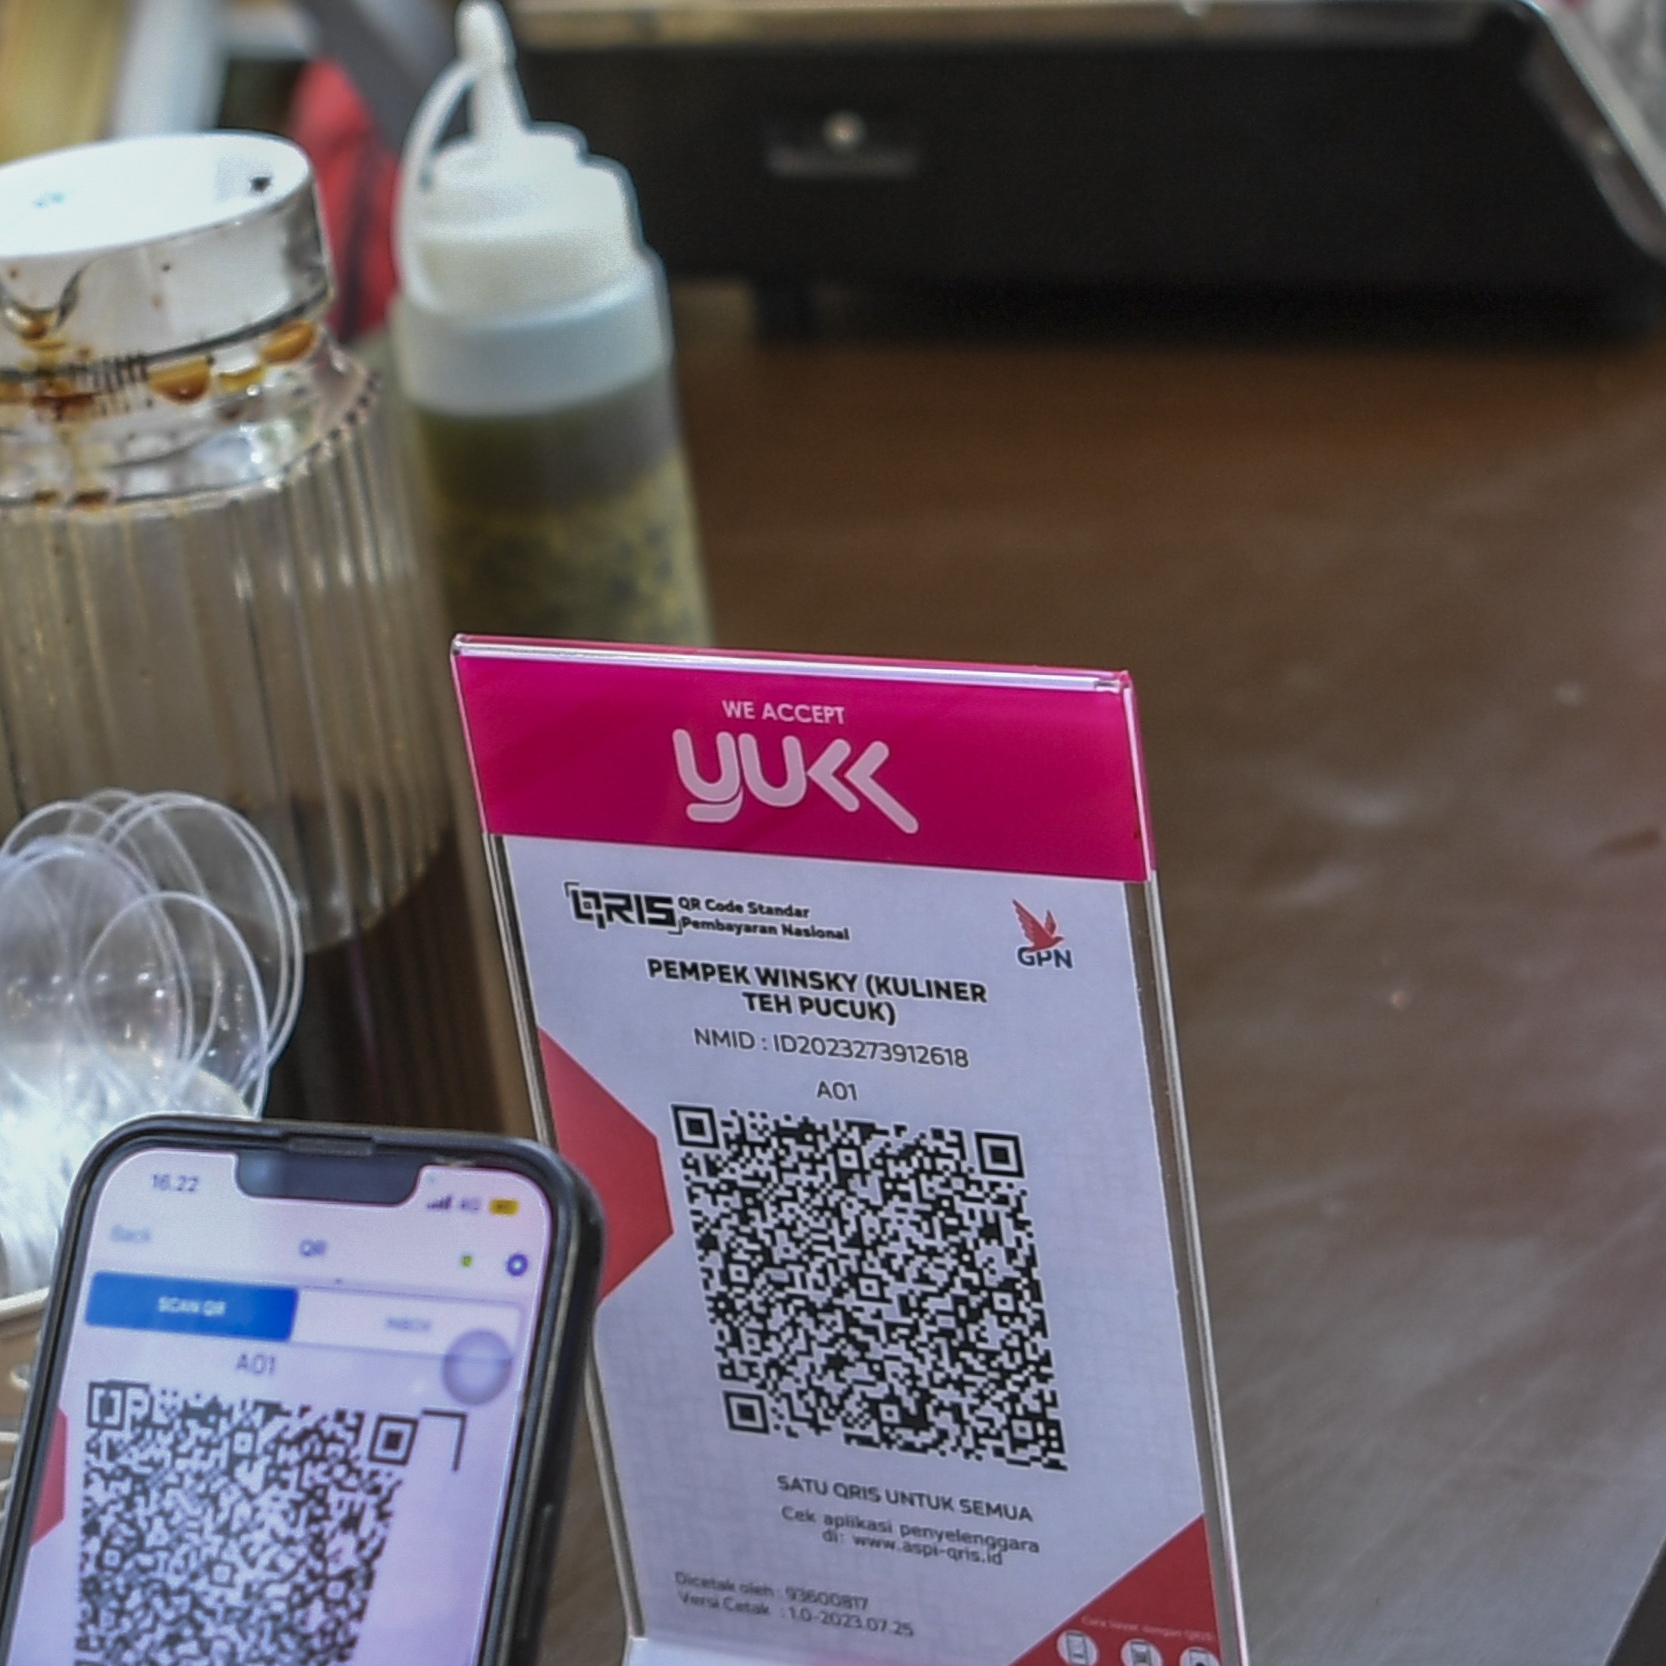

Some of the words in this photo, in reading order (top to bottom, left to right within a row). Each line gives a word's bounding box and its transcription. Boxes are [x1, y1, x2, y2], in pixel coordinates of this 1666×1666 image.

[722, 700, 755, 720] WE
[762, 702, 845, 725] ACCEPT
[568, 886, 680, 932] QRIS
[678, 895, 701, 911] QR
[704, 898, 744, 915] Code
[747, 901, 810, 919] Standar
[681, 916, 778, 937] Pembayaran
[781, 922, 850, 942] Nasional
[1016, 946, 1073, 969] GPN
[647, 957, 751, 986] PEMPEK
[754, 965, 859, 994] WINSKY
[866, 973, 988, 1003] (KULINER
[742, 992, 792, 1015] TEH
[801, 996, 898, 1027] PUCUK)
[693, 1027, 756, 1051] NMID
[773, 1033, 969, 1068] ID2023273912618
[152, 1173, 199, 1193] 16.22
[777, 1474, 828, 1496] SATU
[833, 1481, 881, 1504] QRIS
[885, 1488, 954, 1513] UNTUK
[959, 1498, 1033, 1523] SEMUA
[781, 1506, 816, 1524] Cek
[823, 1512, 893, 1536] aplikasi
[899, 1521, 1040, 1555] penyelenggara
[852, 1533, 1003, 1566] www.aspi-qris.id
[674, 1571, 736, 1592] Dicetak
[723, 1596, 770, 1615] Cetak
